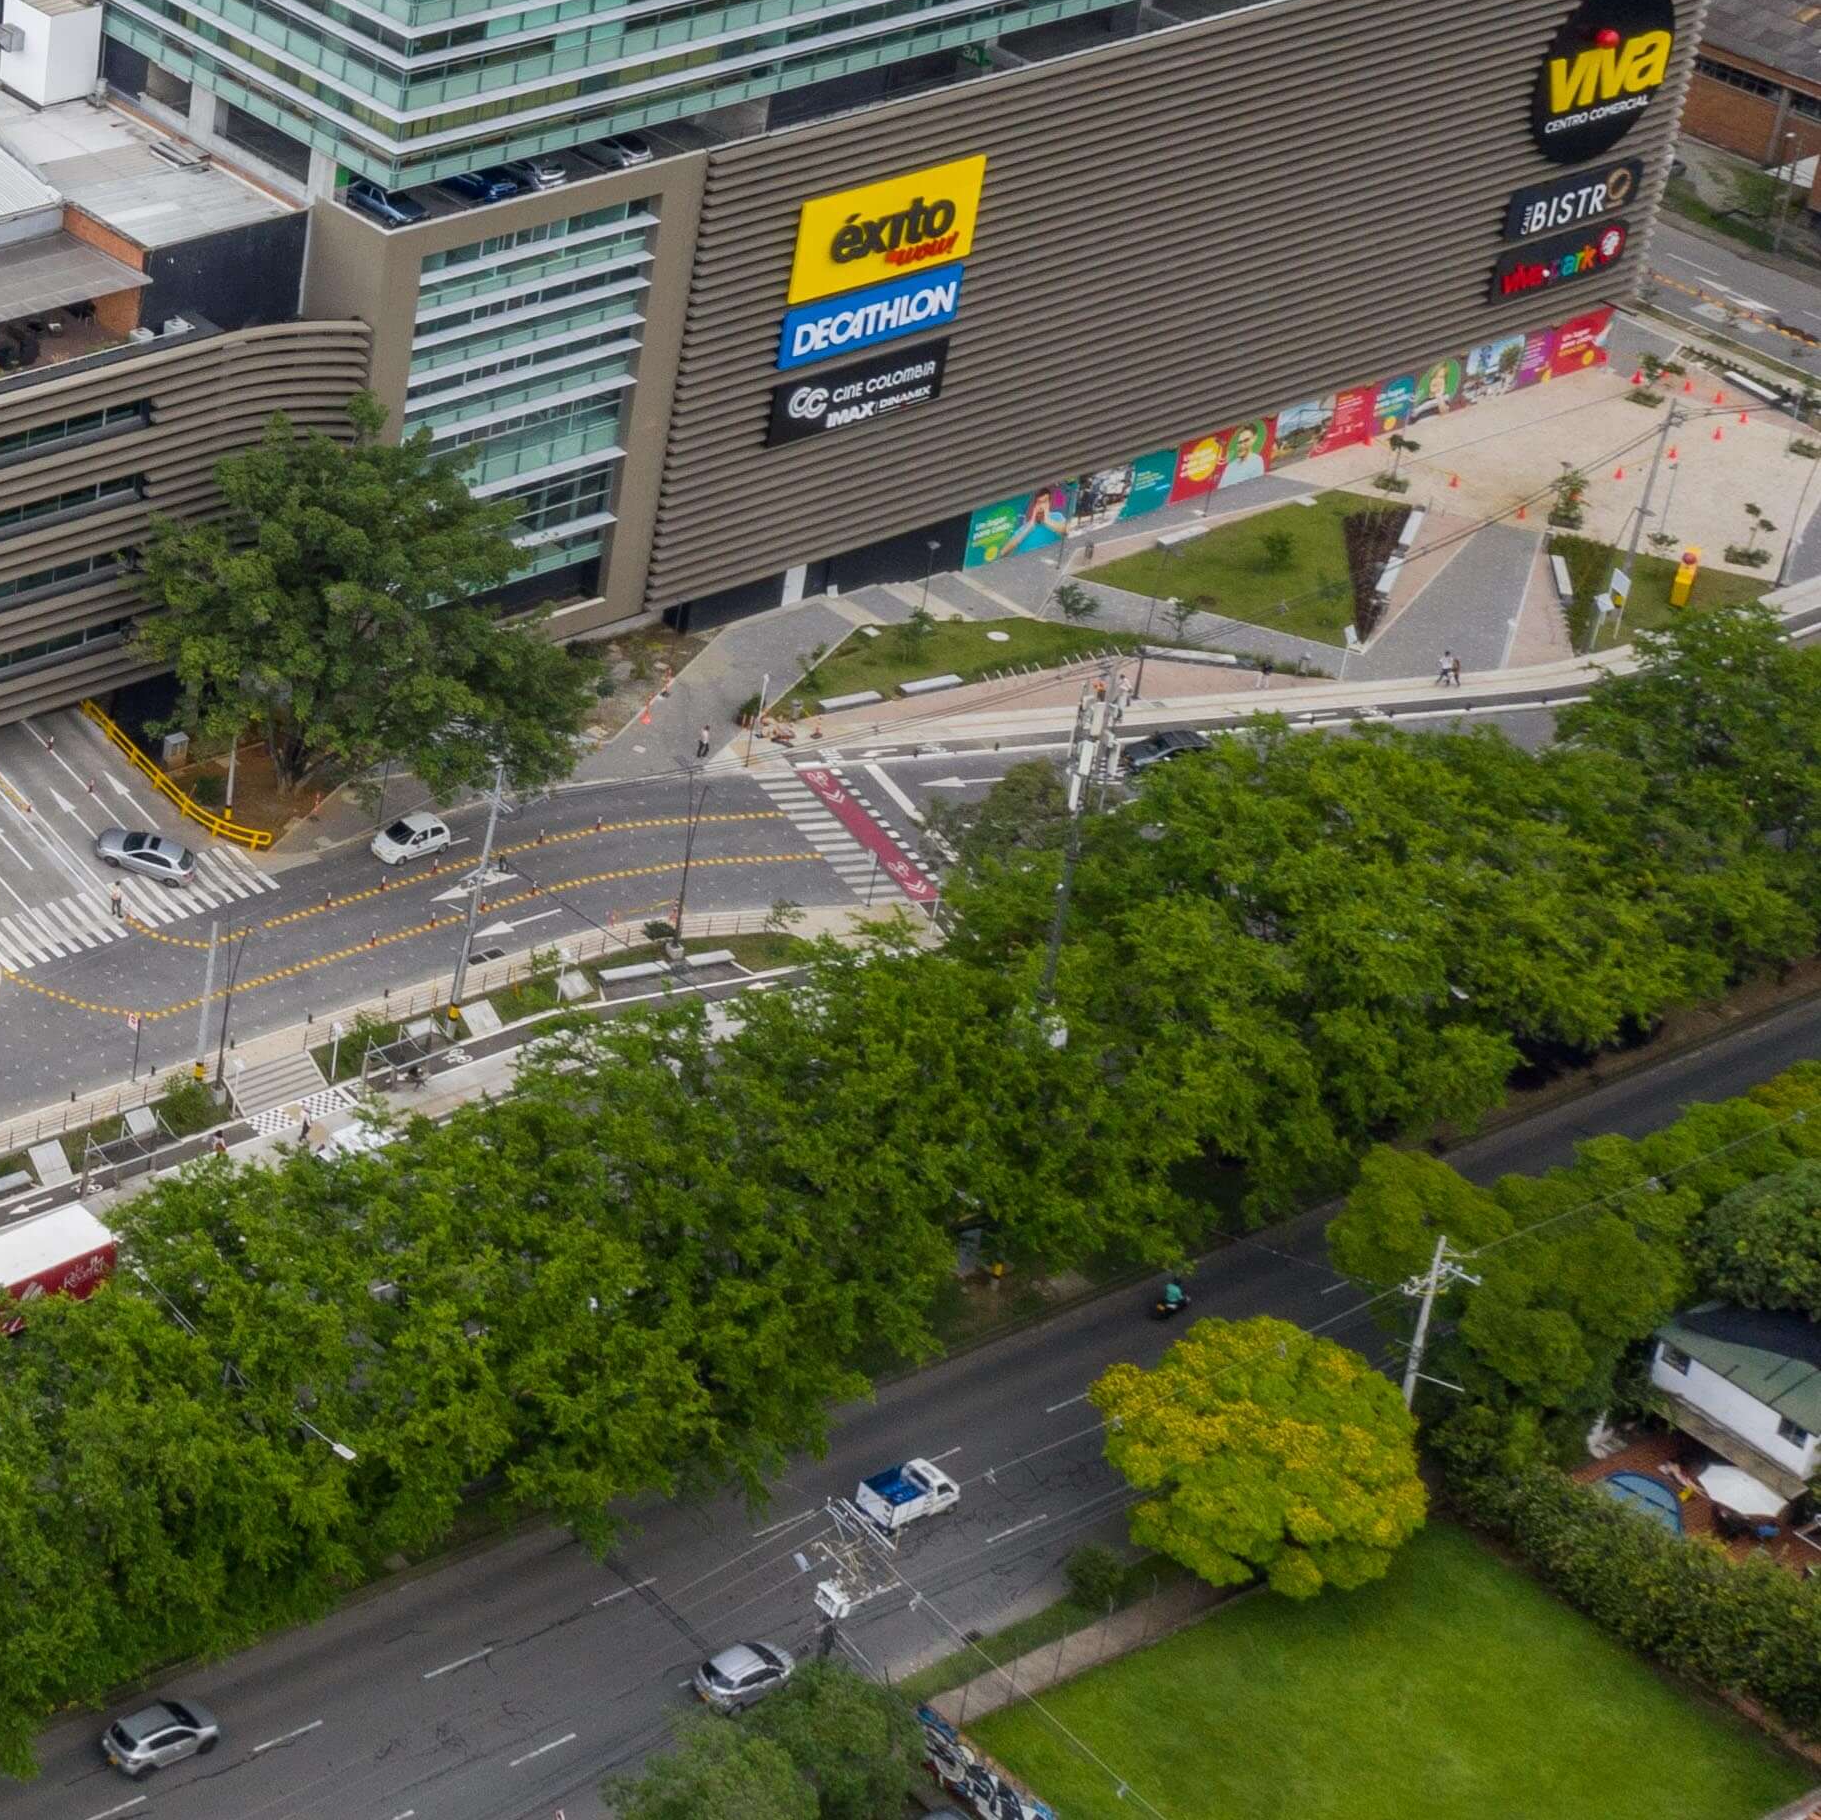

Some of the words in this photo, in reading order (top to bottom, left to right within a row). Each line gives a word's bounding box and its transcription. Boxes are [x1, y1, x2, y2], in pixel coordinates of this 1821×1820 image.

[1548, 28, 1675, 114] viva
[1544, 111, 1589, 134] CENTRO
[1589, 94, 1650, 122] COMERCIAL
[830, 196, 956, 264] éxito
[1529, 167, 1633, 233] BISTRO
[792, 281, 957, 357] DECATHLON
[825, 401, 876, 428] IMAX
[832, 382, 863, 403] CINE
[865, 360, 937, 393] COLOMBIA
